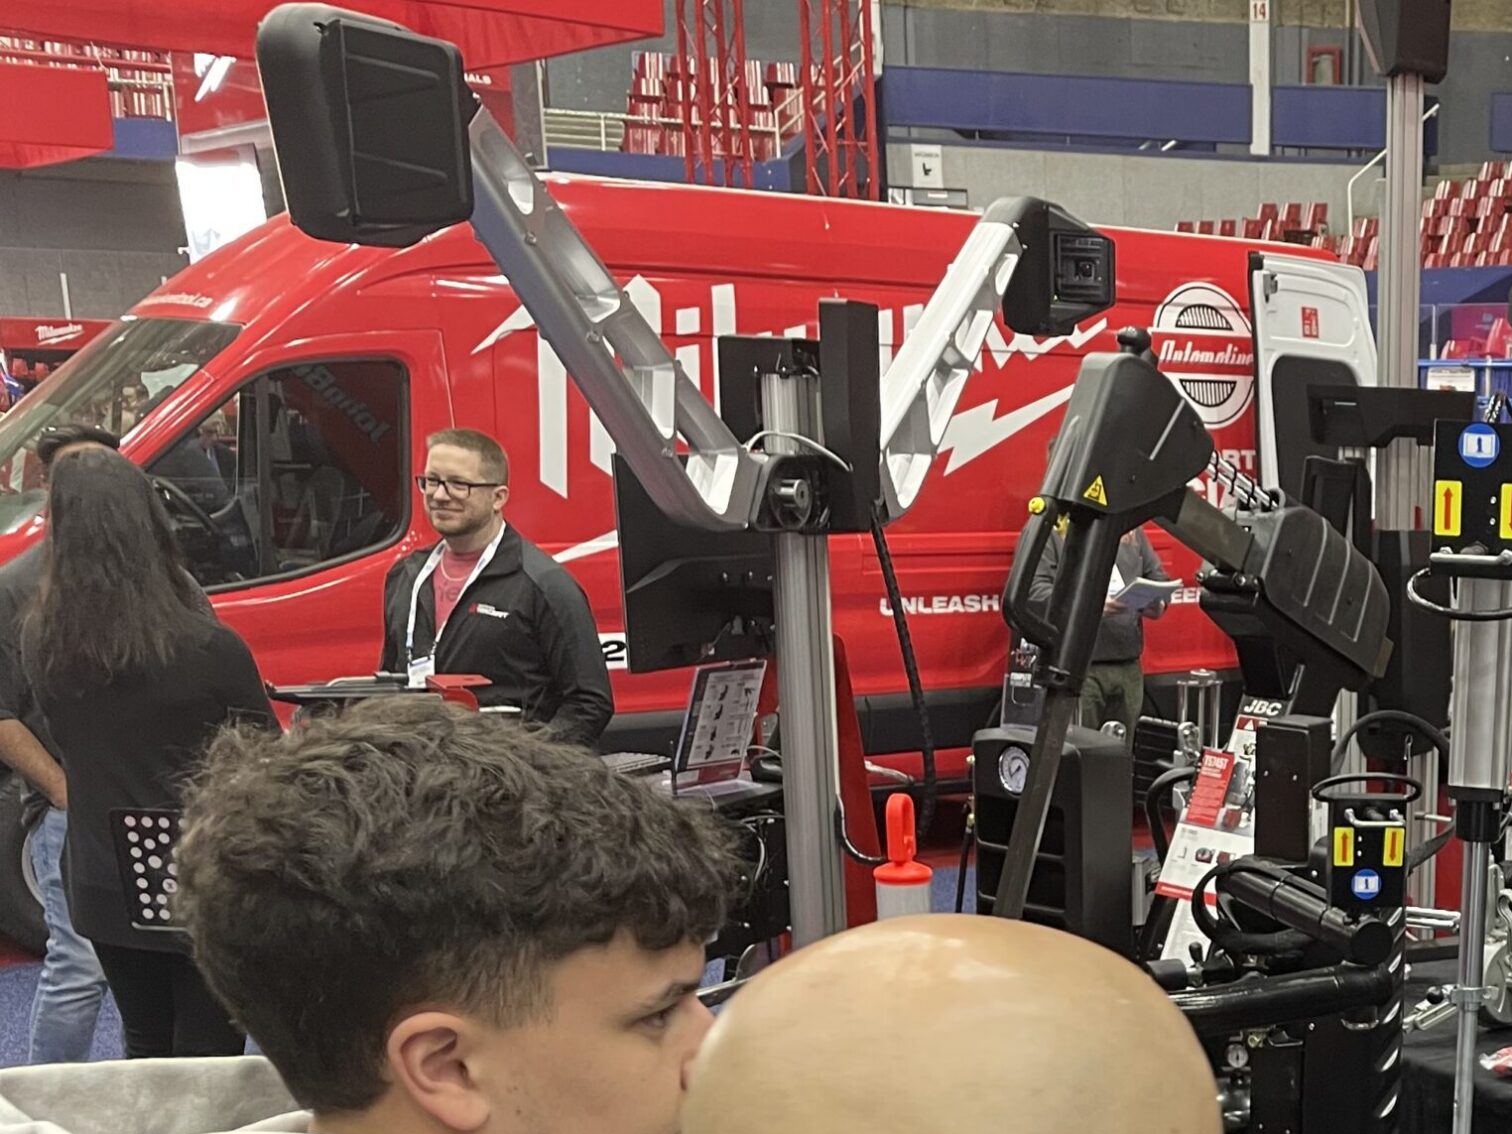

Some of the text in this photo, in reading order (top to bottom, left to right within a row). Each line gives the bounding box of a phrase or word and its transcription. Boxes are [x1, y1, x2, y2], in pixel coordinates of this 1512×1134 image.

[1253, 3, 1266, 19] 14
[879, 594, 1000, 617] UNLEASH
[601, 639, 627, 662] 2
[1243, 699, 1282, 717] JBC
